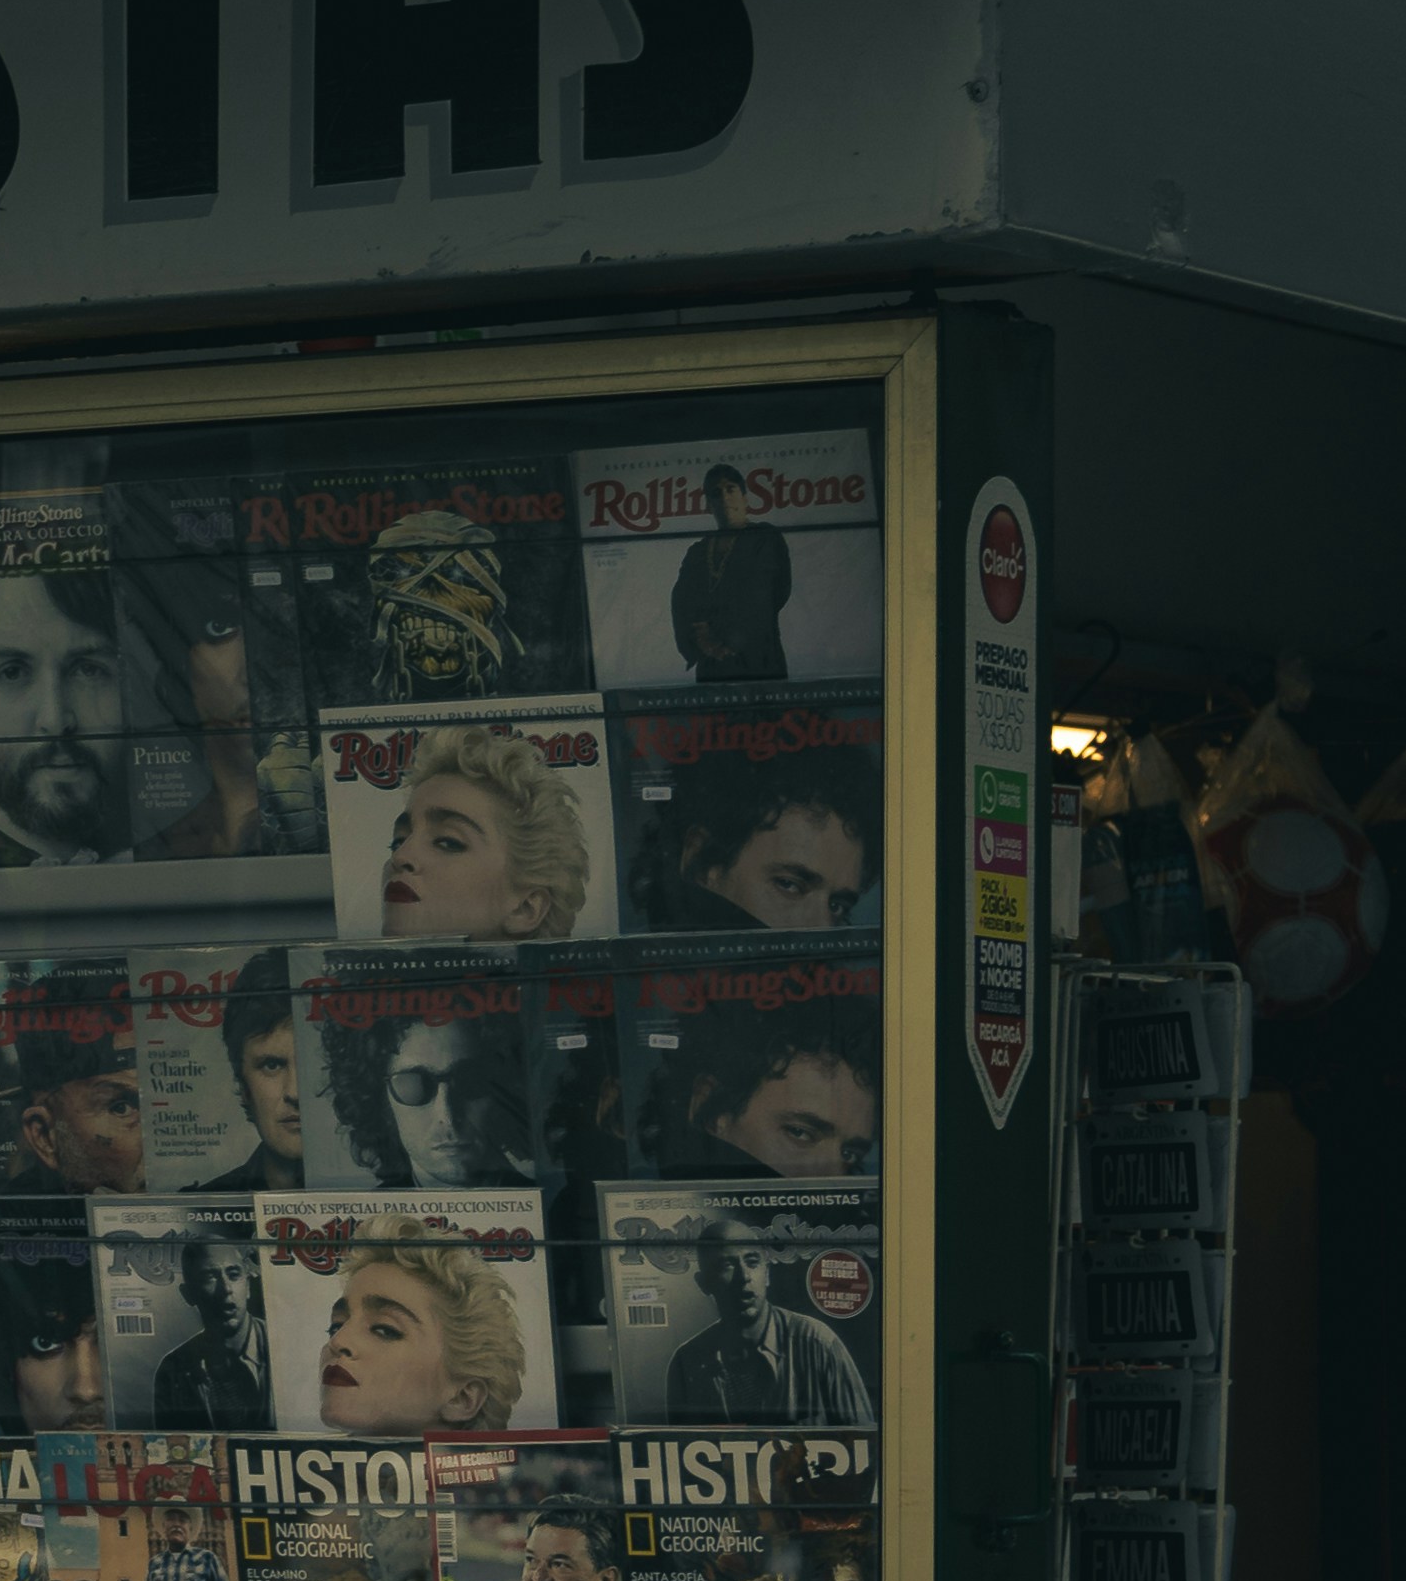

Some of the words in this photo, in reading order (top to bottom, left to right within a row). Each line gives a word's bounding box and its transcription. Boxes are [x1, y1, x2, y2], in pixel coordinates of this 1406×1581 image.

[982, 548, 1019, 580] Claro
[975, 640, 1027, 669] PREPAGO
[975, 664, 1028, 694] MENSUAL
[133, 746, 191, 767] Prince
[979, 939, 1023, 968] 500MB
[979, 1019, 1022, 1045] RECARGÁ
[1107, 1021, 1189, 1080] AGUSTINA
[150, 1061, 207, 1079] Charlie
[152, 1079, 193, 1095] Watts
[1101, 1150, 1189, 1206] CATALINA
[263, 1201, 316, 1216] EDICIÓN
[319, 1201, 381, 1215] ESPECIAL
[383, 1201, 418, 1214] PARA
[420, 1199, 533, 1213] COLECCIONISTAS
[703, 1196, 740, 1208] PARA
[743, 1193, 860, 1208] COLECCIONISTAS
[1101, 1280, 1183, 1336] LUANA
[1094, 1409, 1173, 1462] MICAELA
[660, 1517, 740, 1534] NATIONAL
[660, 1536, 764, 1554] GEOGRAPHIC
